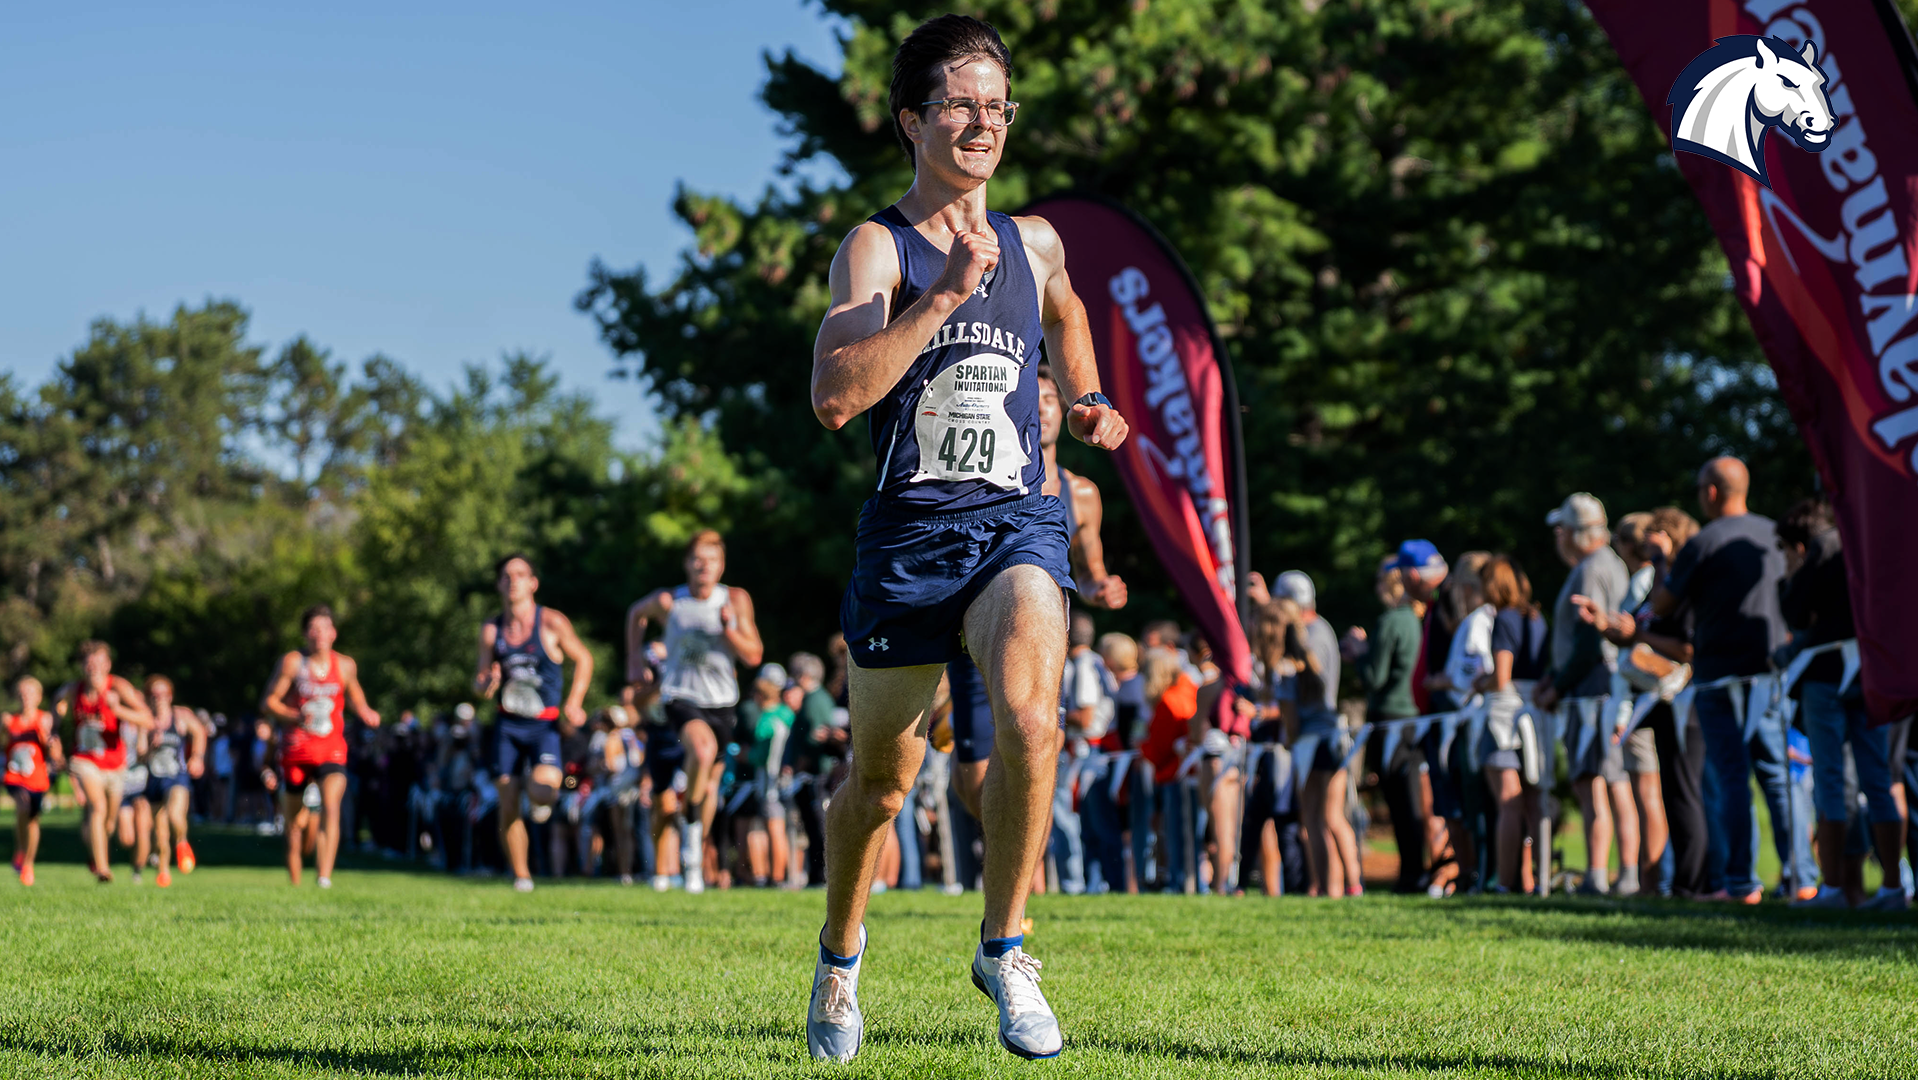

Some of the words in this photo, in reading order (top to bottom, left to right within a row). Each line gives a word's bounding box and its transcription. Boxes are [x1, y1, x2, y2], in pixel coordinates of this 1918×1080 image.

[955, 364, 1008, 381] SPARTAN
[954, 380, 1008, 393] INVITATIONAL
[948, 411, 975, 420] MICHIGAN
[976, 413, 991, 421] STATE
[938, 427, 996, 474] 429
